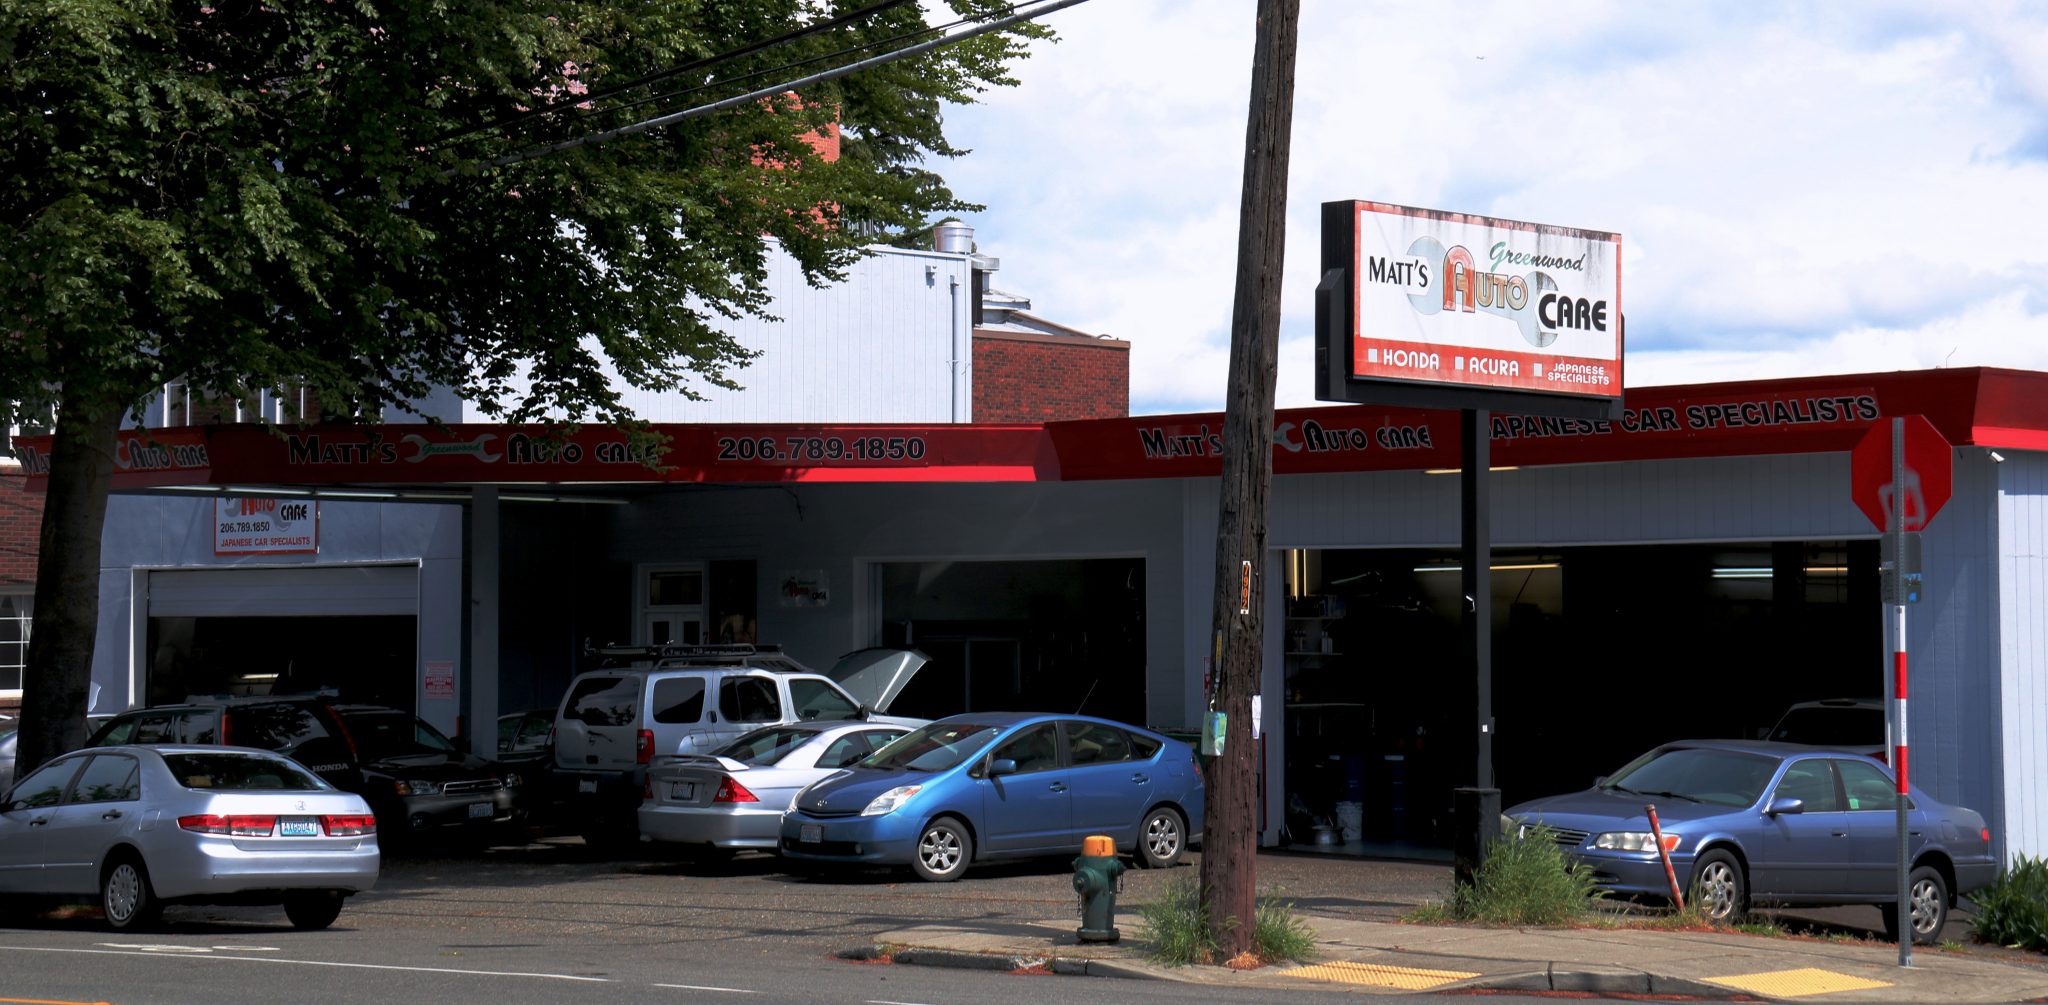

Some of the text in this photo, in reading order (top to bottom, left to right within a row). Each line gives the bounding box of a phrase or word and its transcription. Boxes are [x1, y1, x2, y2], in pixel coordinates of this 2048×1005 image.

[1490, 241, 1586, 272] Greenwood
[1369, 245, 1607, 332] MATT'S AUTO CARE
[1383, 349, 1520, 377] HONDA ACURA
[1552, 363, 1605, 375] JAPANESE
[1547, 371, 1610, 386] SPECIALISTS
[1489, 395, 1879, 440] APANESE CAR SPECIALISTS
[288, 432, 398, 465] MATT'S
[718, 436, 927, 462] 206.789.1850
[1138, 419, 1434, 459] MATT'S AUTO CARE
[128, 438, 171, 470] AUTO
[280, 504, 308, 520] CARE
[220, 521, 270, 533] 206.789.1850
[221, 536, 311, 548] JAPANESE CAR SPECIALISTS
[312, 762, 350, 773] HONDA
